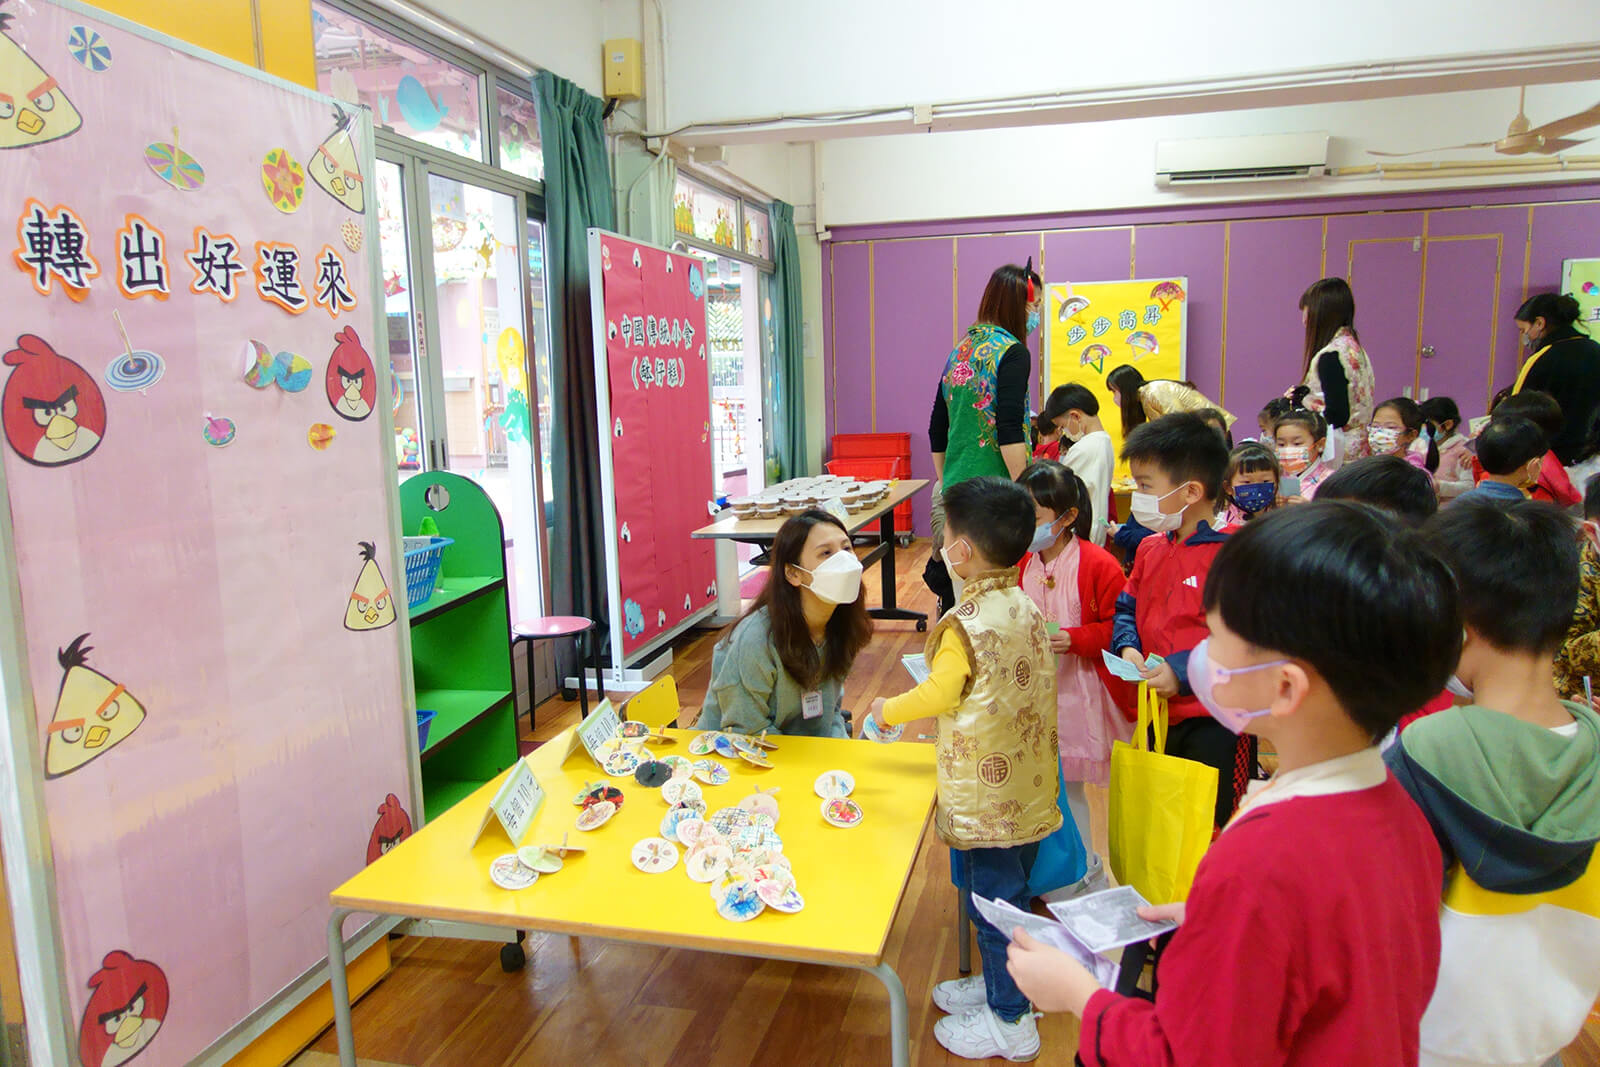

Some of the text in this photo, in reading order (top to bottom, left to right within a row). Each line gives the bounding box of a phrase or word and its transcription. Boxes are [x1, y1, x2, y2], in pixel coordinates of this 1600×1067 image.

[24, 206, 354, 310] 轉出好運來
[620, 313, 695, 350] 中國傳統小食
[1066, 304, 1161, 346] 步步高昇
[981, 756, 1009, 784] 福
